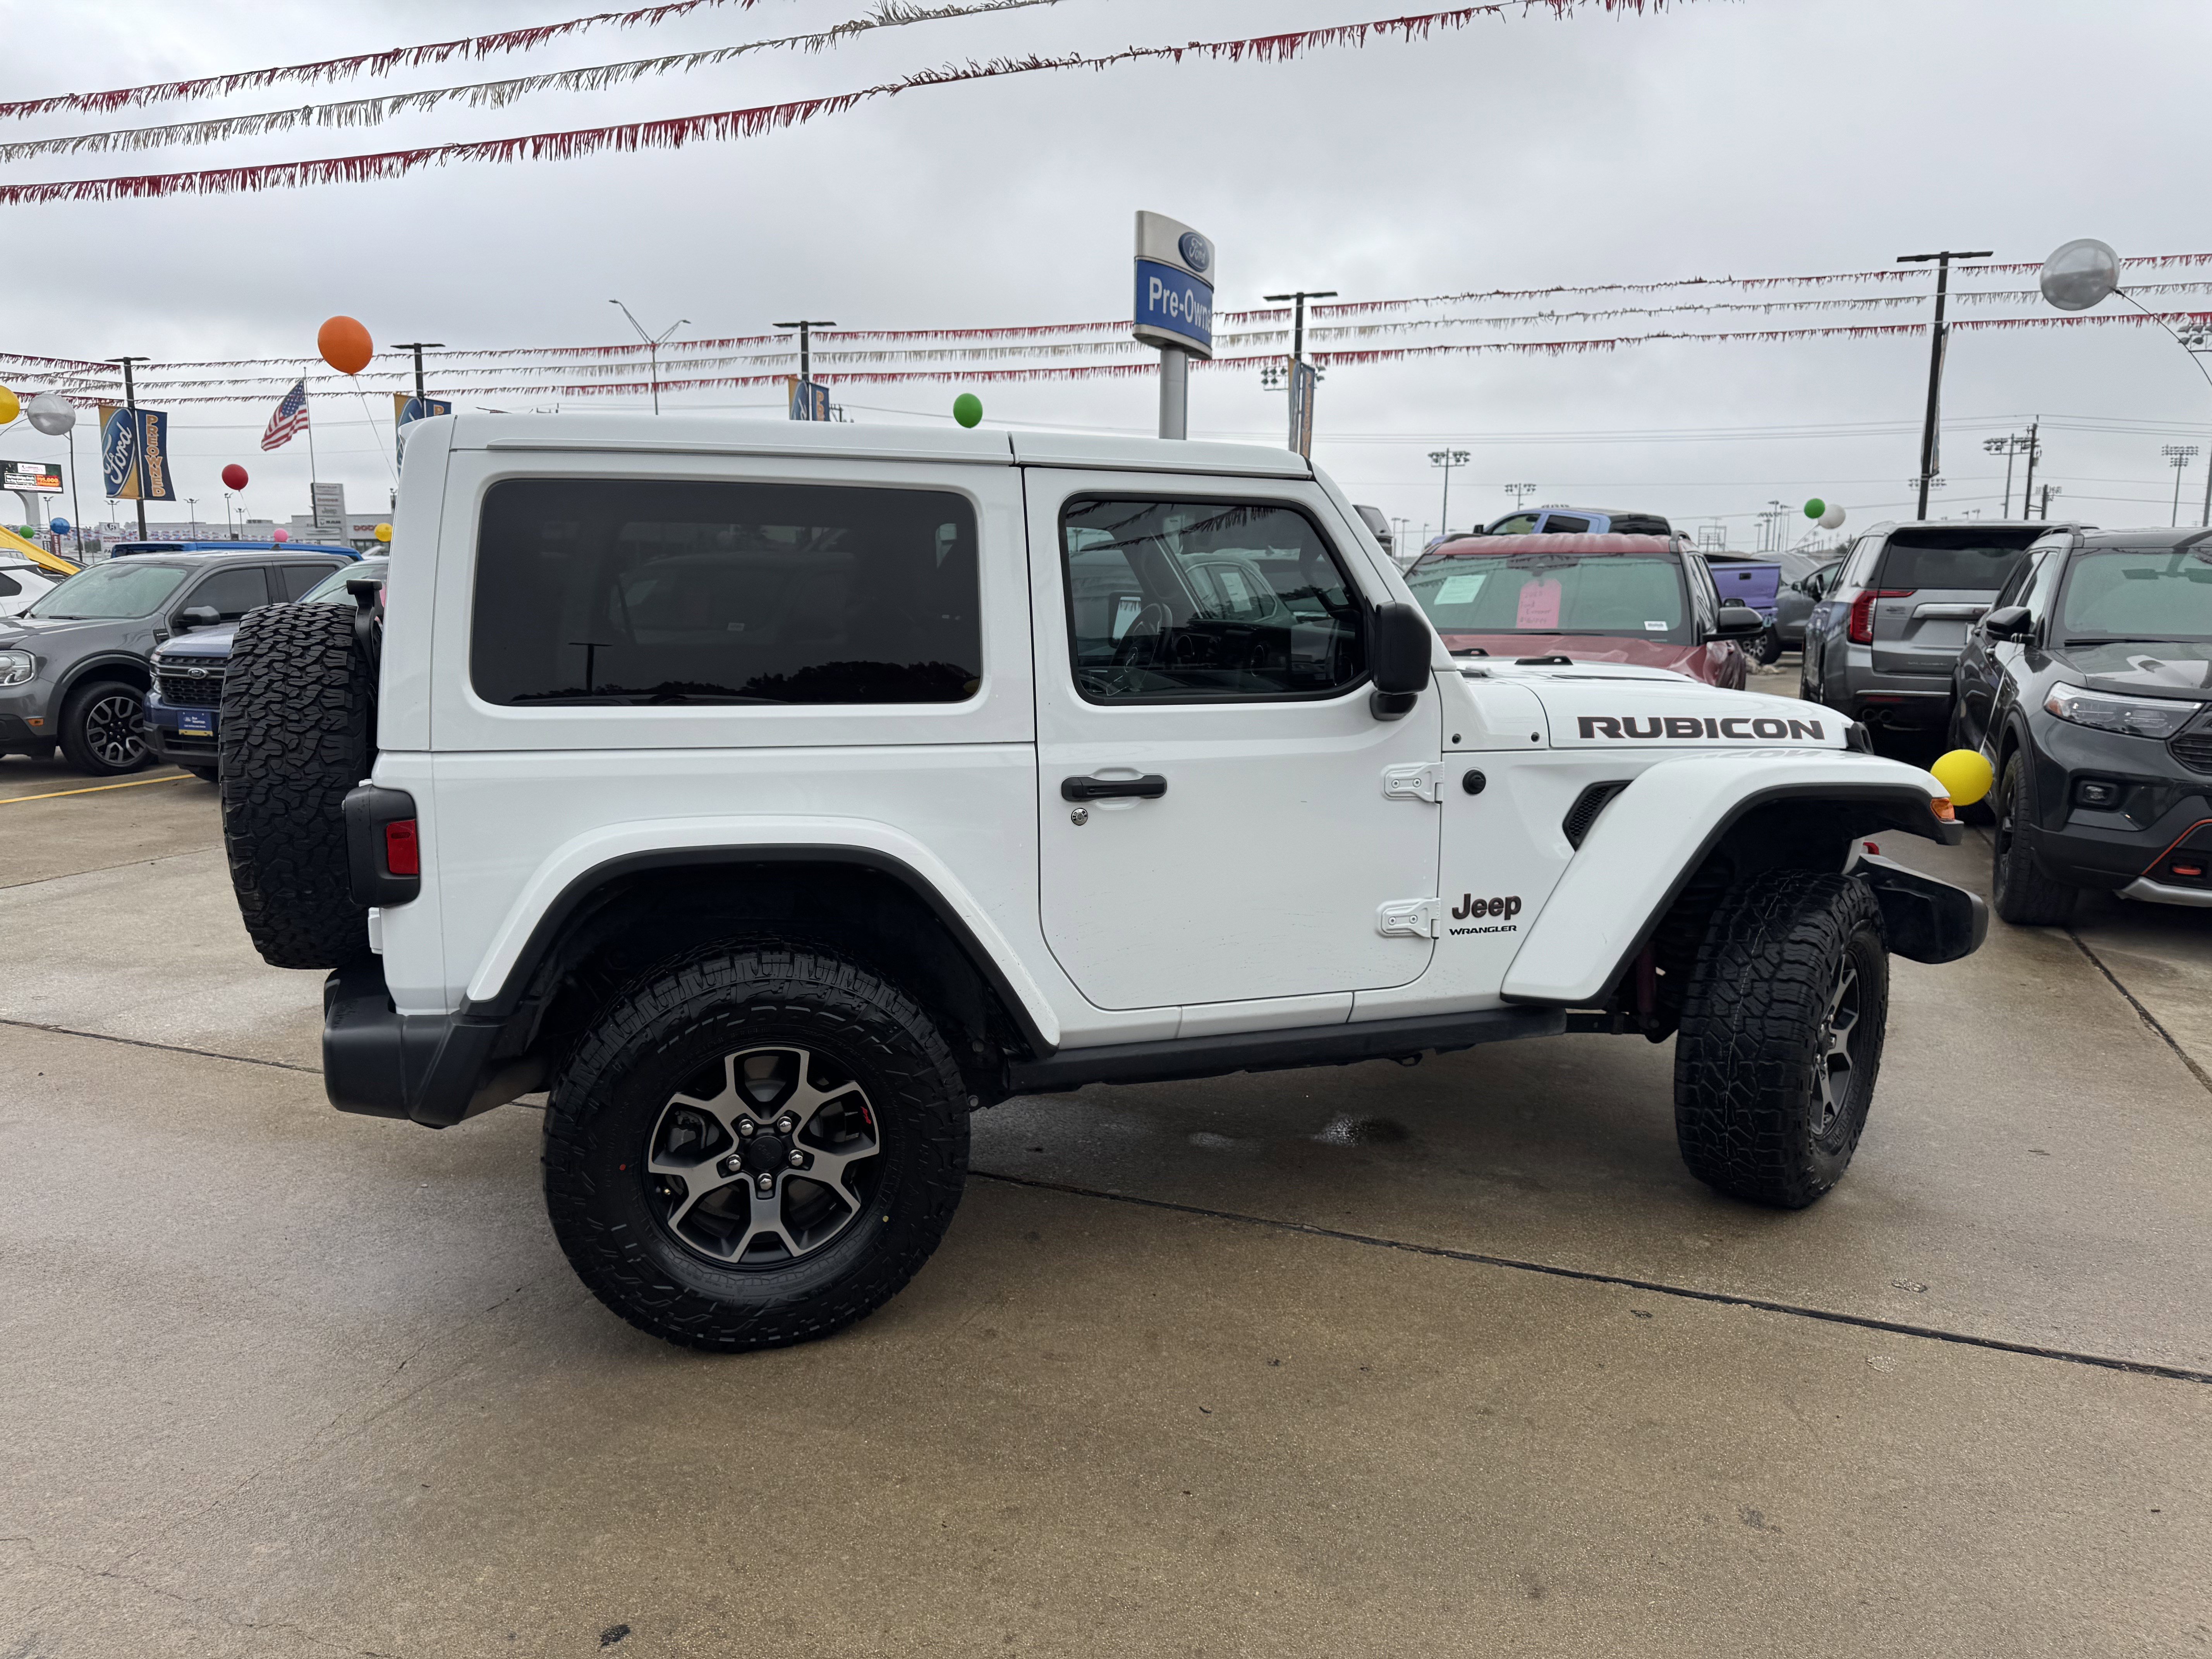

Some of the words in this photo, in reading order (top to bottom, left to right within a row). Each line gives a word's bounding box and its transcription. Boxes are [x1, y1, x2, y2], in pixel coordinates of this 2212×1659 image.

[1189, 238, 1206, 263] Ford
[103, 421, 132, 484] Ford
[144, 414, 165, 497] PREOWNED
[1577, 716, 1825, 740] RUBICON
[1452, 893, 1522, 921] Jeep
[1449, 925, 1517, 935] WRANGLER
